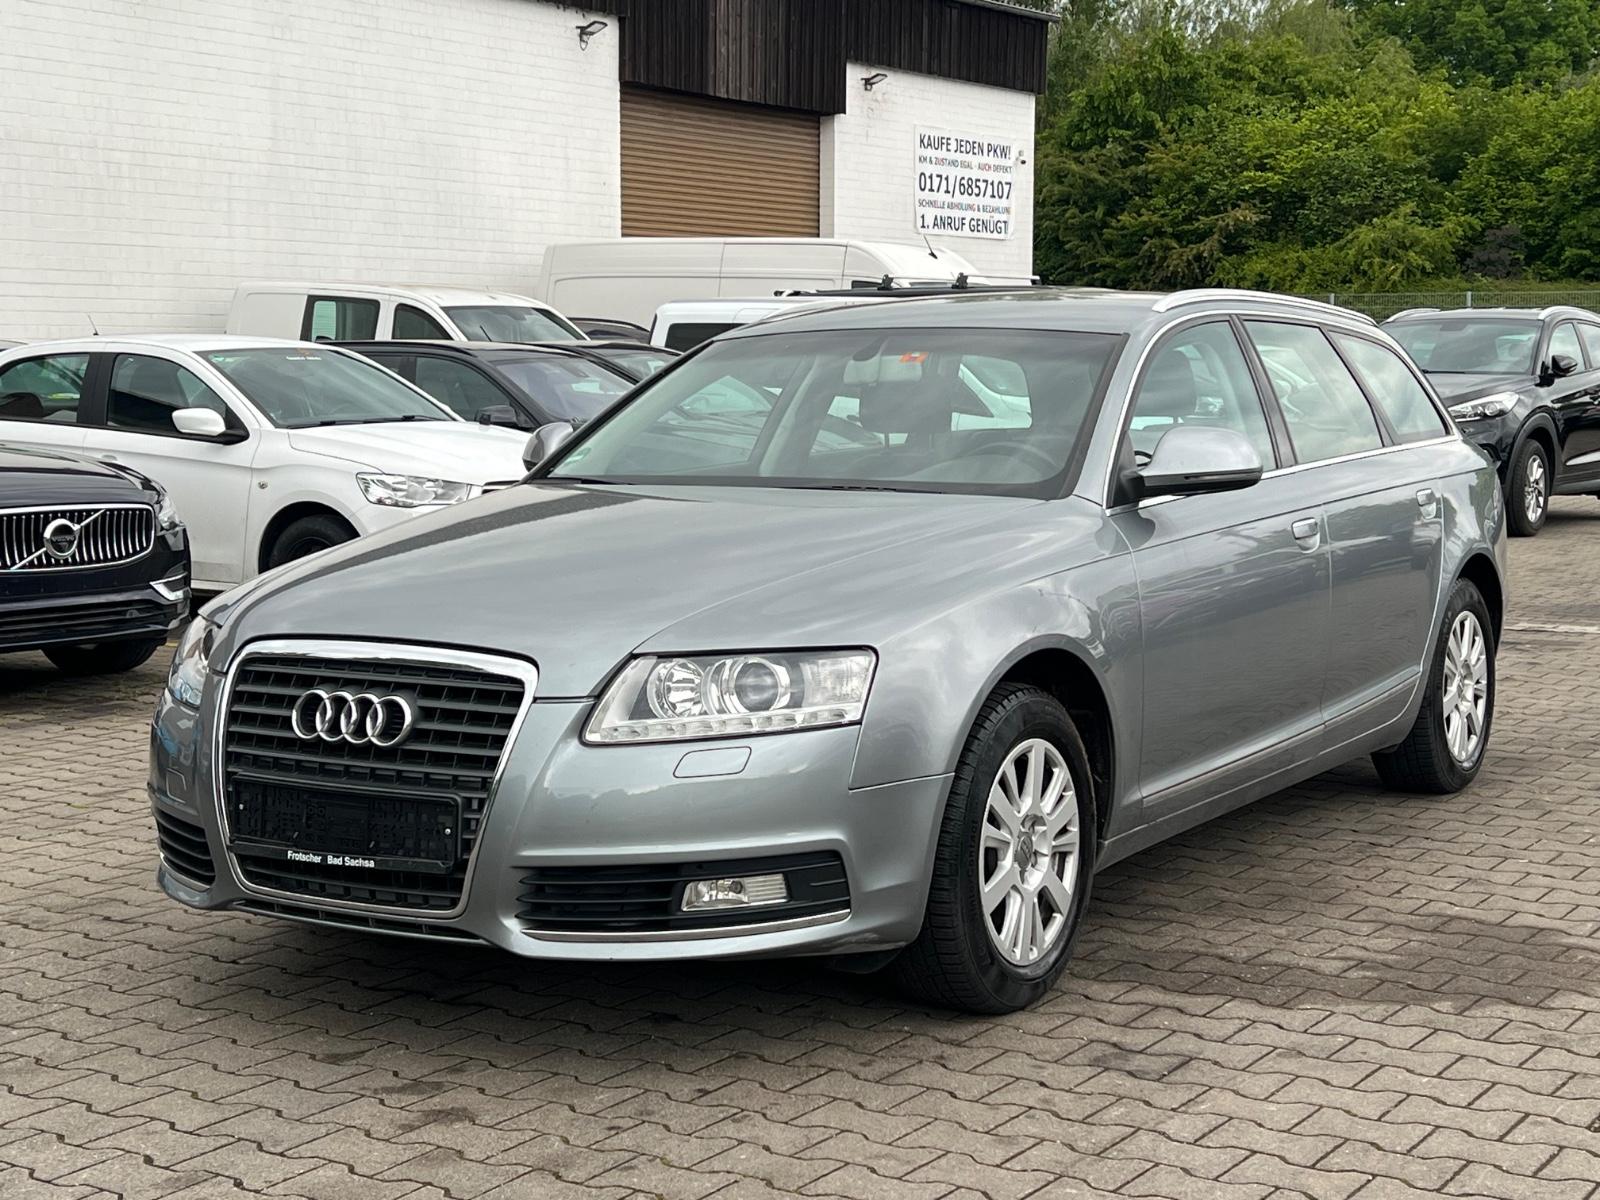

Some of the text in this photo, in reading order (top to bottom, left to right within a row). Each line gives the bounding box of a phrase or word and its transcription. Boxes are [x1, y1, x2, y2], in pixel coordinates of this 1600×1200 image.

[919, 133, 1011, 160] KAUFE JEDEN PKW!
[929, 156, 933, 164] &
[934, 157, 959, 168] ZUSTAND
[960, 161, 973, 170] EGAL
[978, 163, 992, 172] AUCH
[993, 164, 1012, 174] DEFEKT
[919, 172, 1012, 200] 0171/6857107
[918, 199, 1011, 215] SCHNELLE ABHOLUNG & BEZAHLUN
[920, 214, 930, 229] 1.
[933, 214, 966, 232] ANRUF
[287, 850, 375, 868] Frotscher Bad Sachsa
